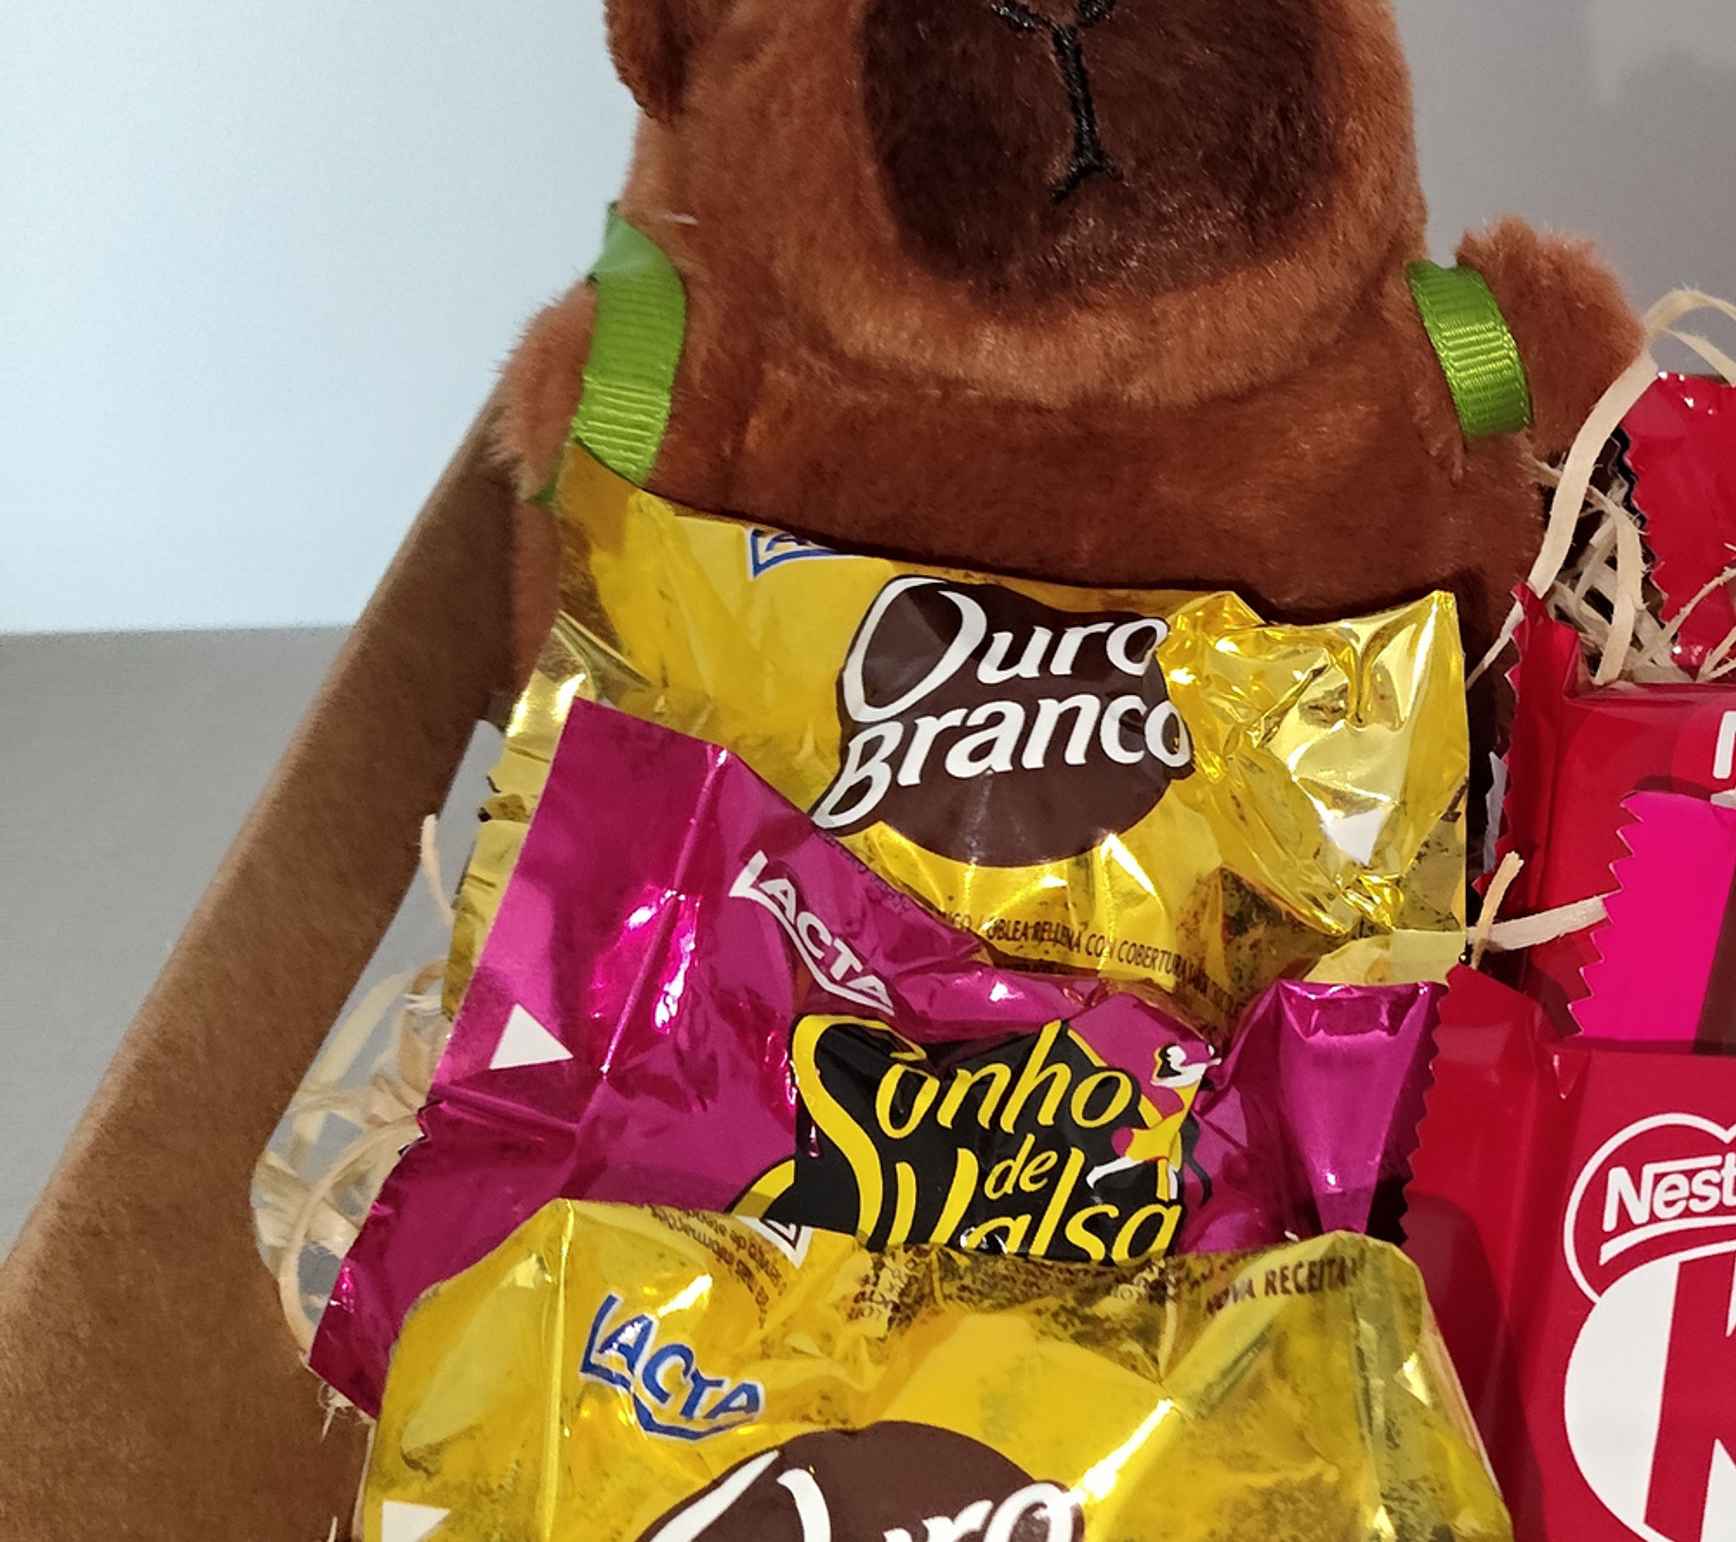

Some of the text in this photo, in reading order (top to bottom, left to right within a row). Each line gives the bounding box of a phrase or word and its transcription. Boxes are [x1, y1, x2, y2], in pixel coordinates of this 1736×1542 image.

[842, 576, 1169, 722] Ouro
[812, 694, 1192, 829] Branco
[729, 849, 894, 1016] LACTA
[793, 1013, 1134, 1245] Sonho
[984, 1133, 1058, 1200] de
[579, 1293, 761, 1441] LACTA
